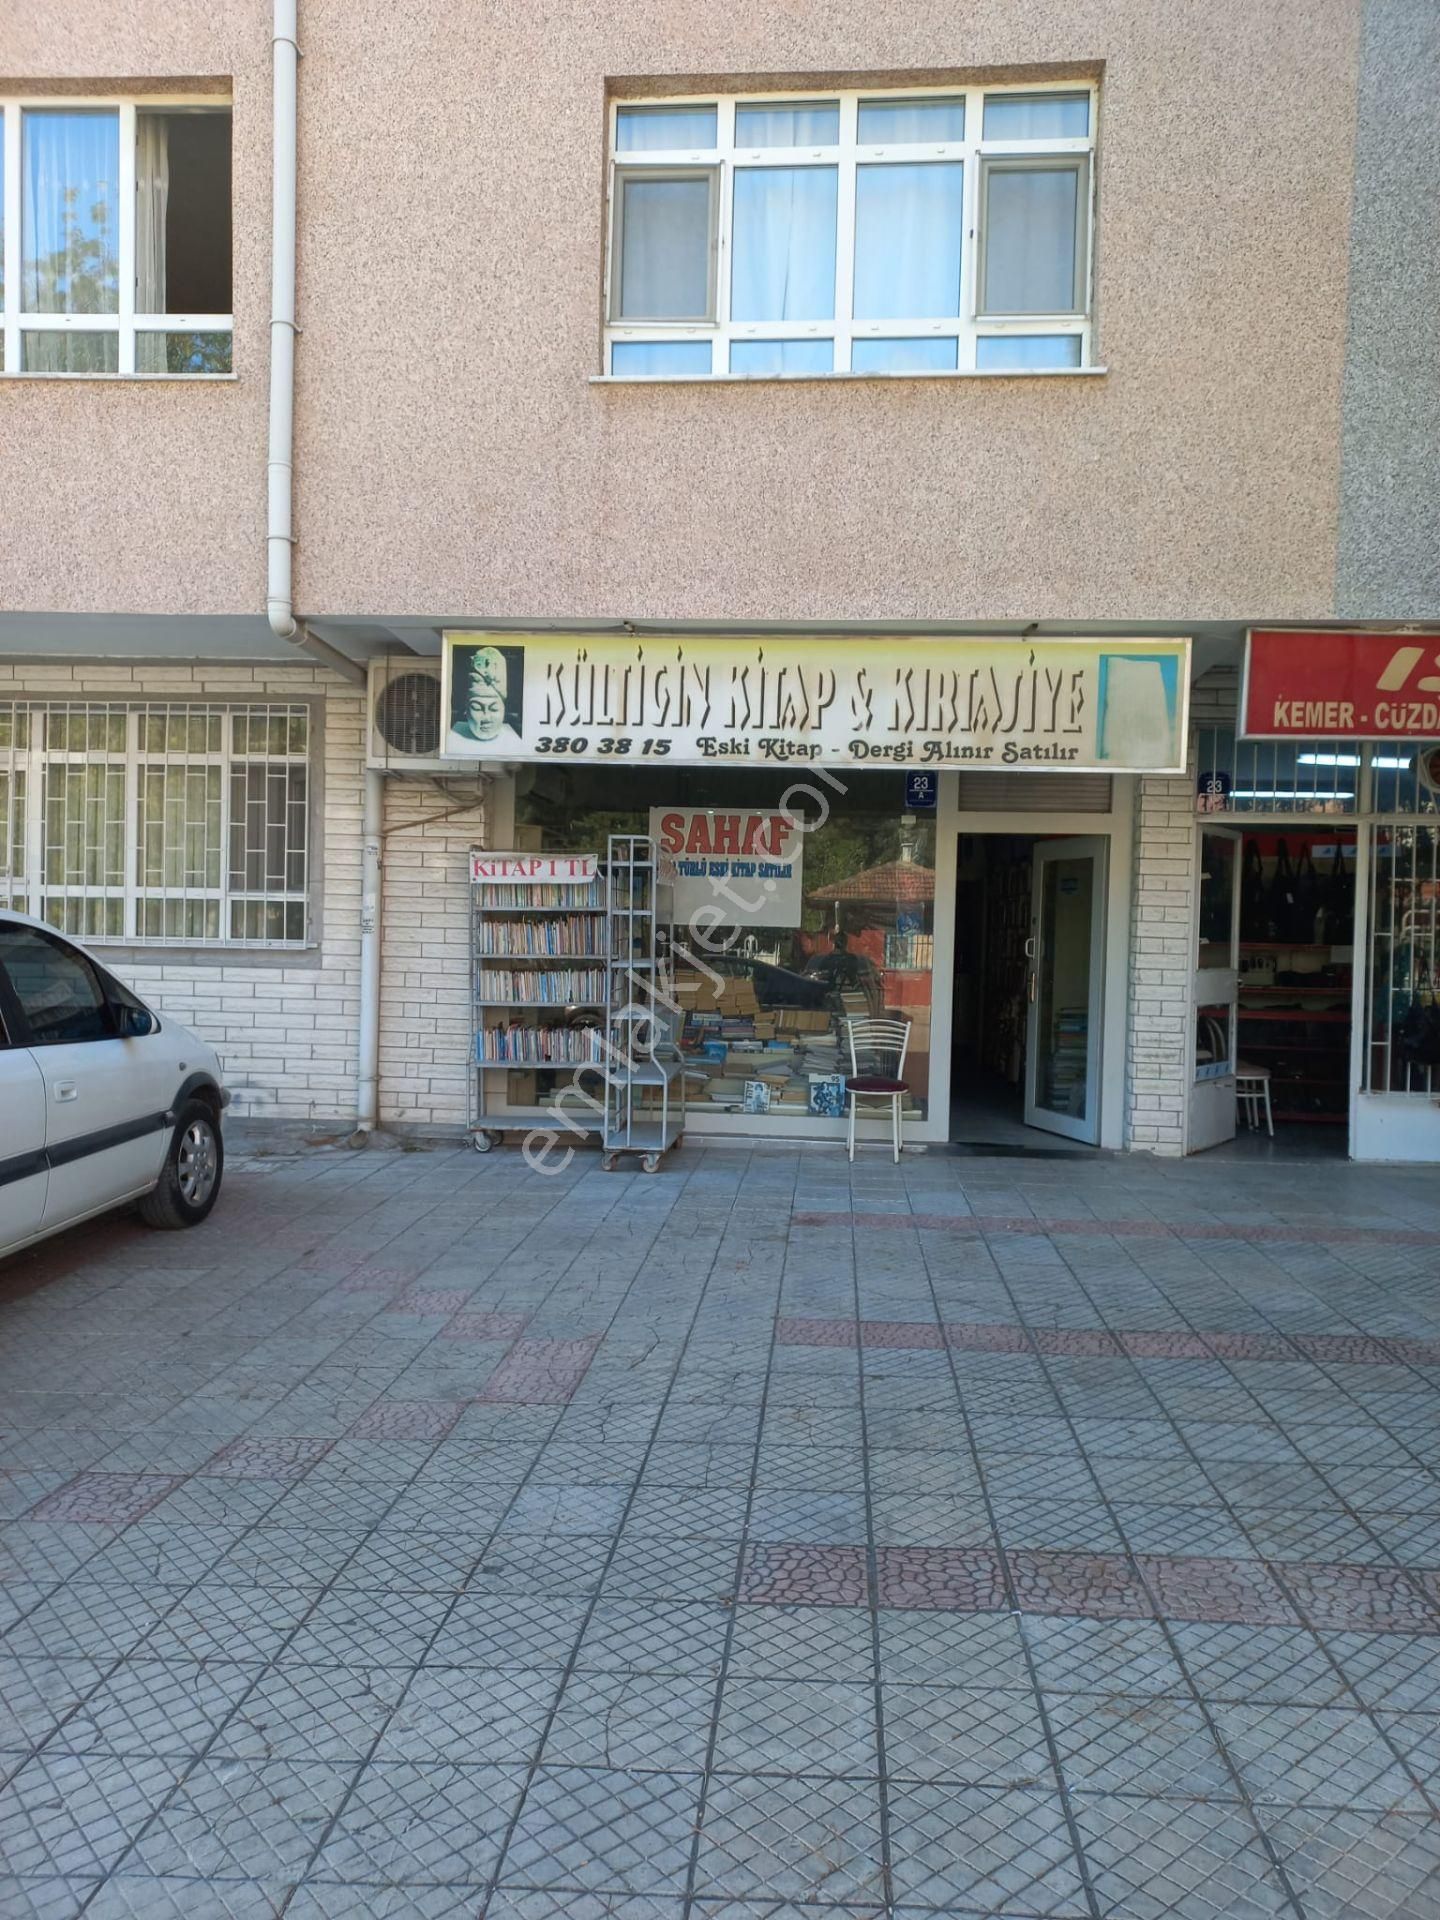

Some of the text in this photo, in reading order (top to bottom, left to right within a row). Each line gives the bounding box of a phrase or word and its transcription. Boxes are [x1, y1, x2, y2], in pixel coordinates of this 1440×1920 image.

[724, 645, 836, 731] KİTAP
[887, 649, 1084, 734] KIRTASİYE
[1273, 701, 1354, 728] KEMER
[1375, 702, 1440, 730] CÜZD
[535, 737, 588, 754] 380
[597, 738, 632, 754] 38
[641, 739, 672, 755] 15
[696, 737, 750, 757] Eski
[758, 738, 823, 761] Kitap
[848, 739, 914, 761] Dergi
[920, 740, 994, 763] Alınır
[1001, 741, 1079, 764] Satılır
[913, 776, 928, 790] 23
[1206, 779, 1222, 793] 23
[918, 791, 924, 799] A
[660, 813, 794, 855] SAHAF
[564, 859, 596, 877] TL
